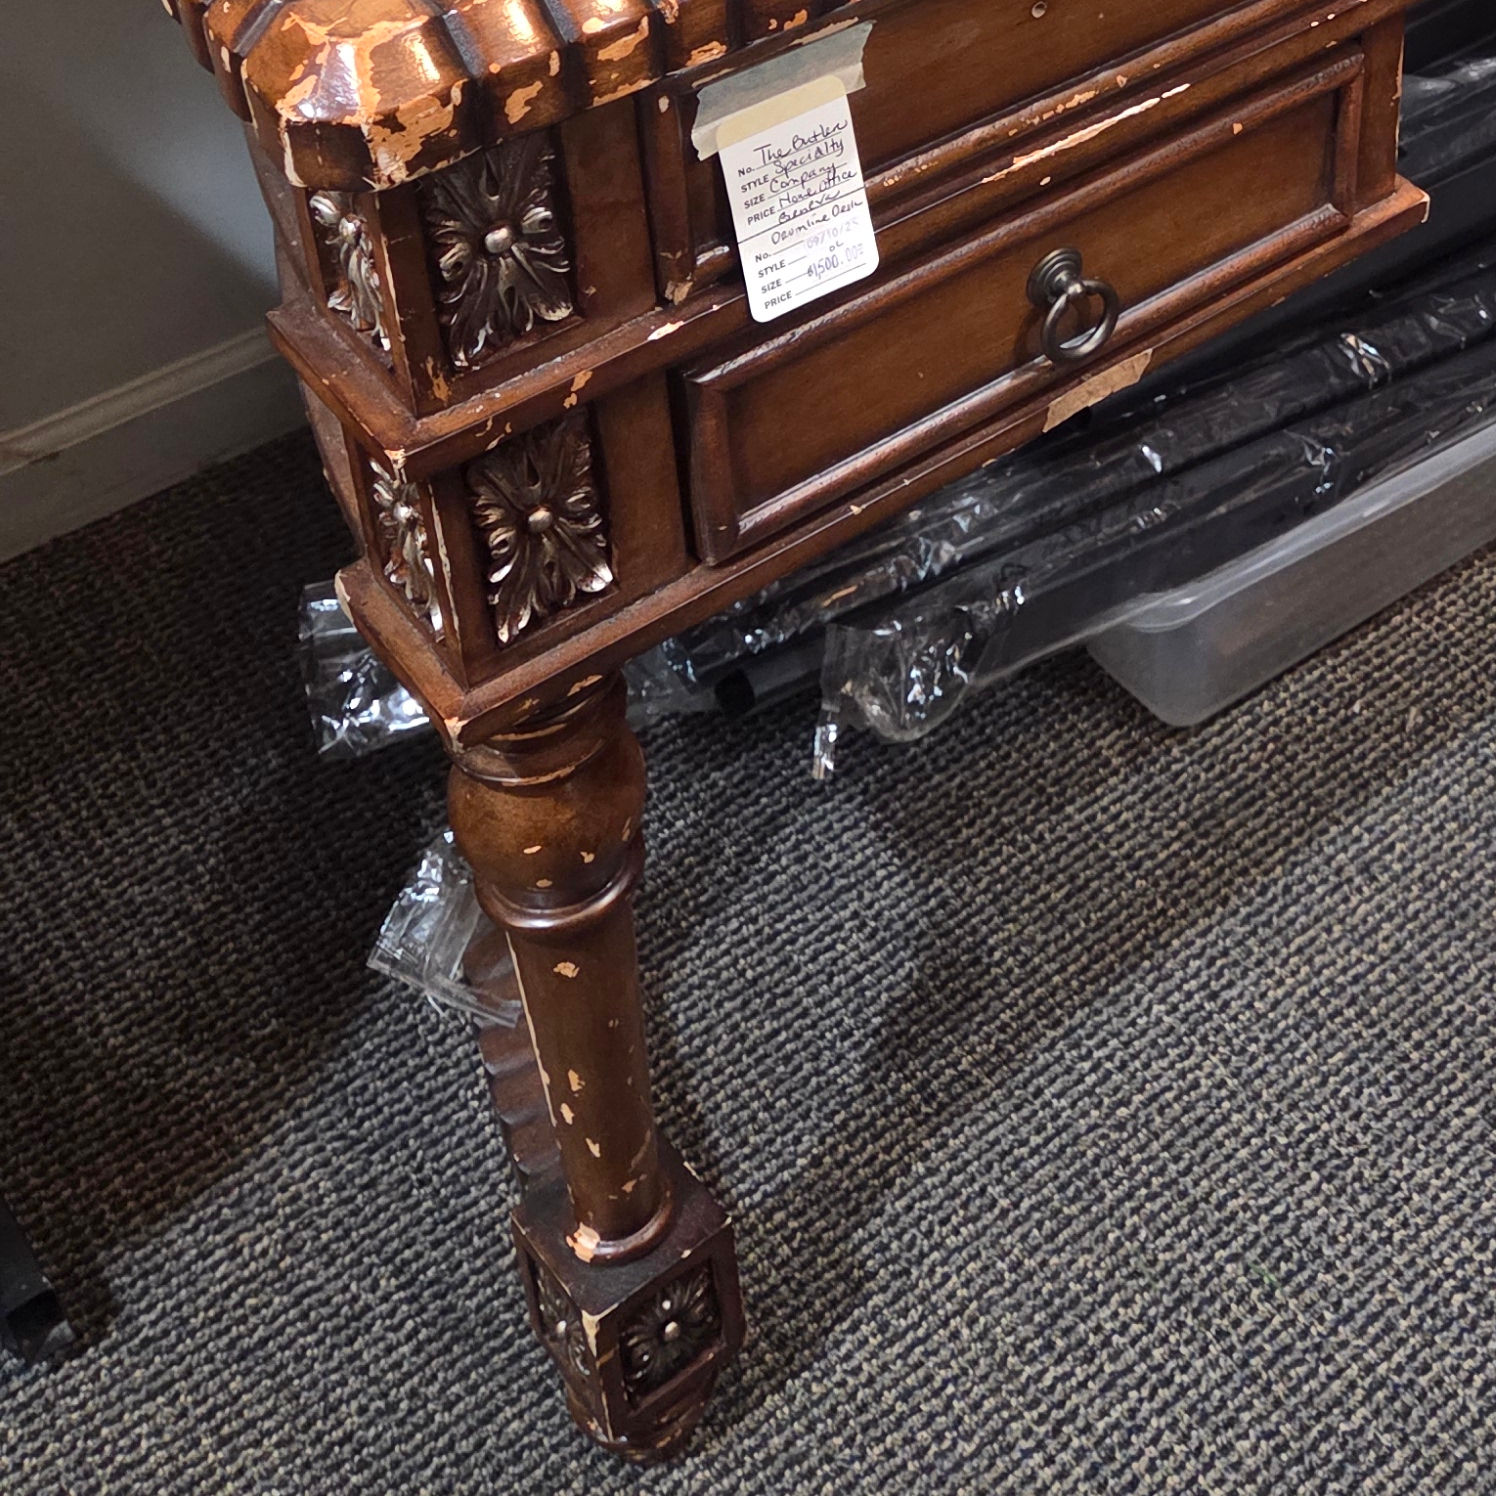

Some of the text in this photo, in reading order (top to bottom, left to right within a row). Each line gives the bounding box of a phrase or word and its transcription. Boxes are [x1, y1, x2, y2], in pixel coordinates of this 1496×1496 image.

[738, 167, 755, 177] No.
[753, 144, 792, 165] The
[741, 175, 769, 193] STYLE
[744, 163, 836, 209] SIZE Company
[747, 206, 777, 225] PRICE
[755, 253, 772, 263] No.
[757, 260, 786, 278] STYLE
[761, 279, 782, 294] SIZE
[764, 291, 792, 309] PRICE
